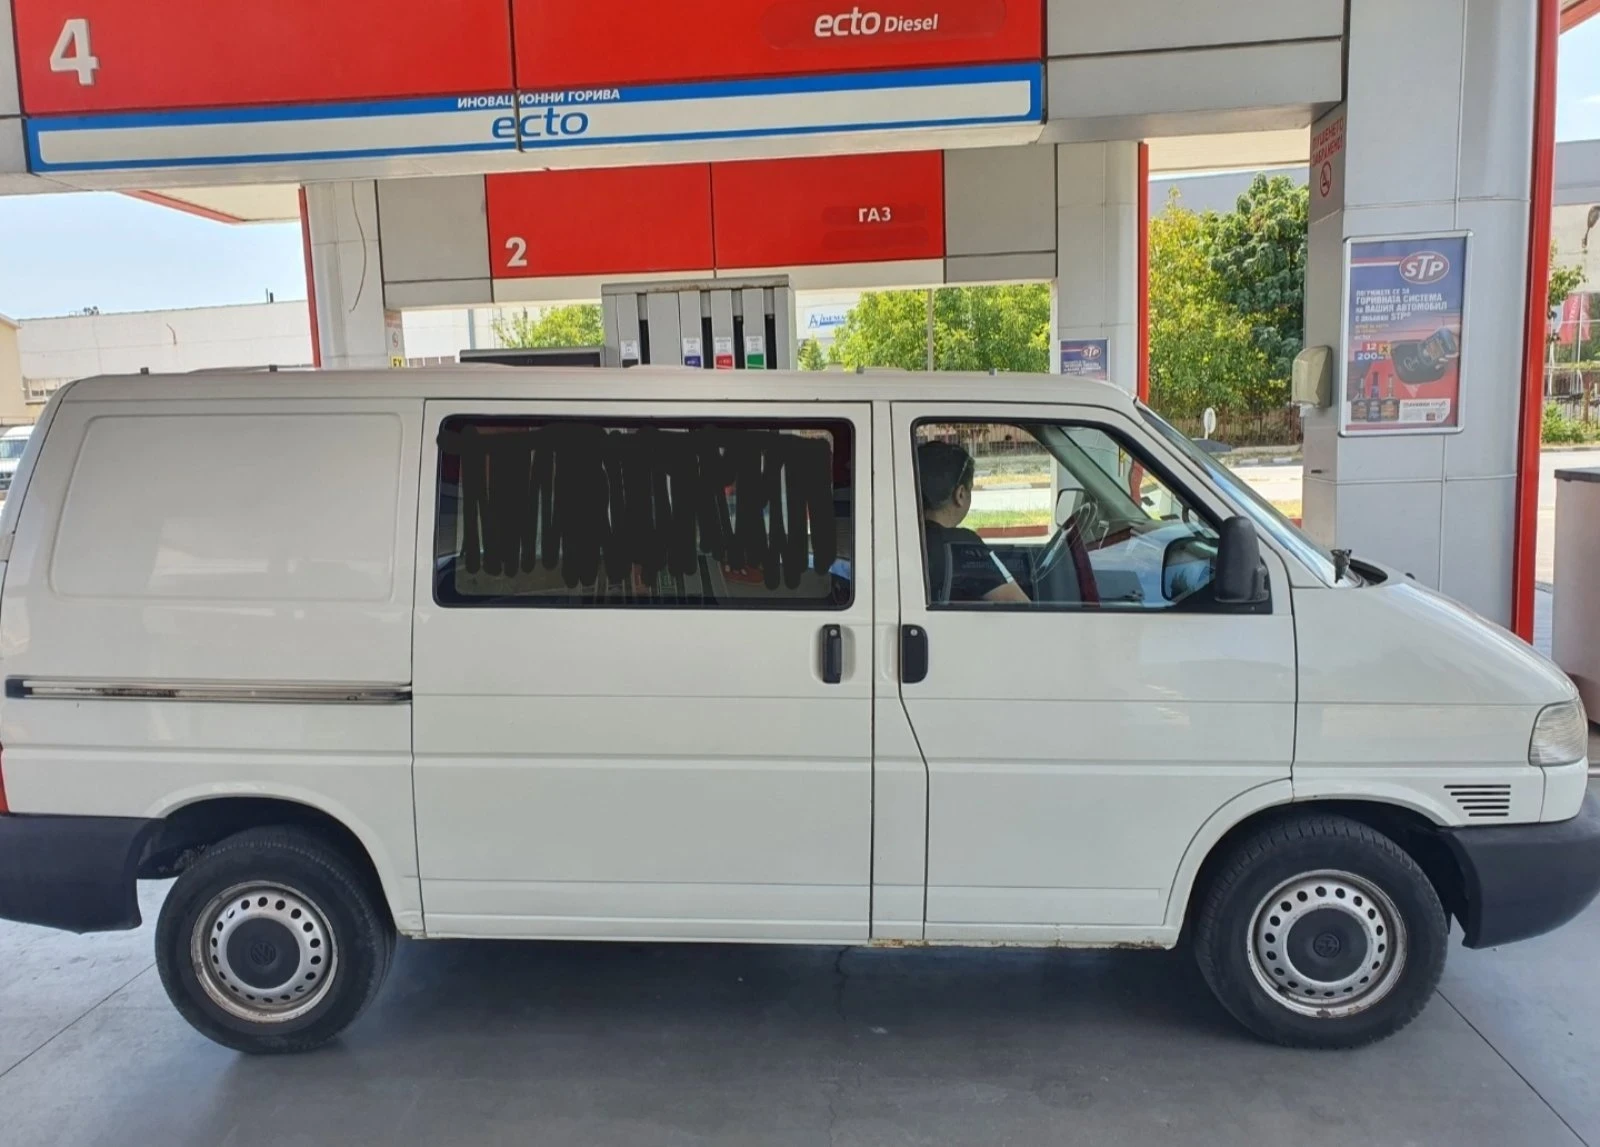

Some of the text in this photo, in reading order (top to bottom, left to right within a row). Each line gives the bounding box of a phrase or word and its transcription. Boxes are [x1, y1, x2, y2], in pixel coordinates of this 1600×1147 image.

[814, 6, 939, 37] ecto Diesel
[50, 18, 99, 86] 4
[457, 88, 621, 109] ИНОВАЦИОННИ ГОРИВА
[491, 107, 589, 139] ecto
[858, 206, 892, 223] ГАЗ
[505, 236, 528, 267] 2
[1404, 255, 1444, 280] STP
[1396, 301, 1448, 312] АВТОМОБИЛ
[1402, 292, 1443, 303] СИСТЕМА
